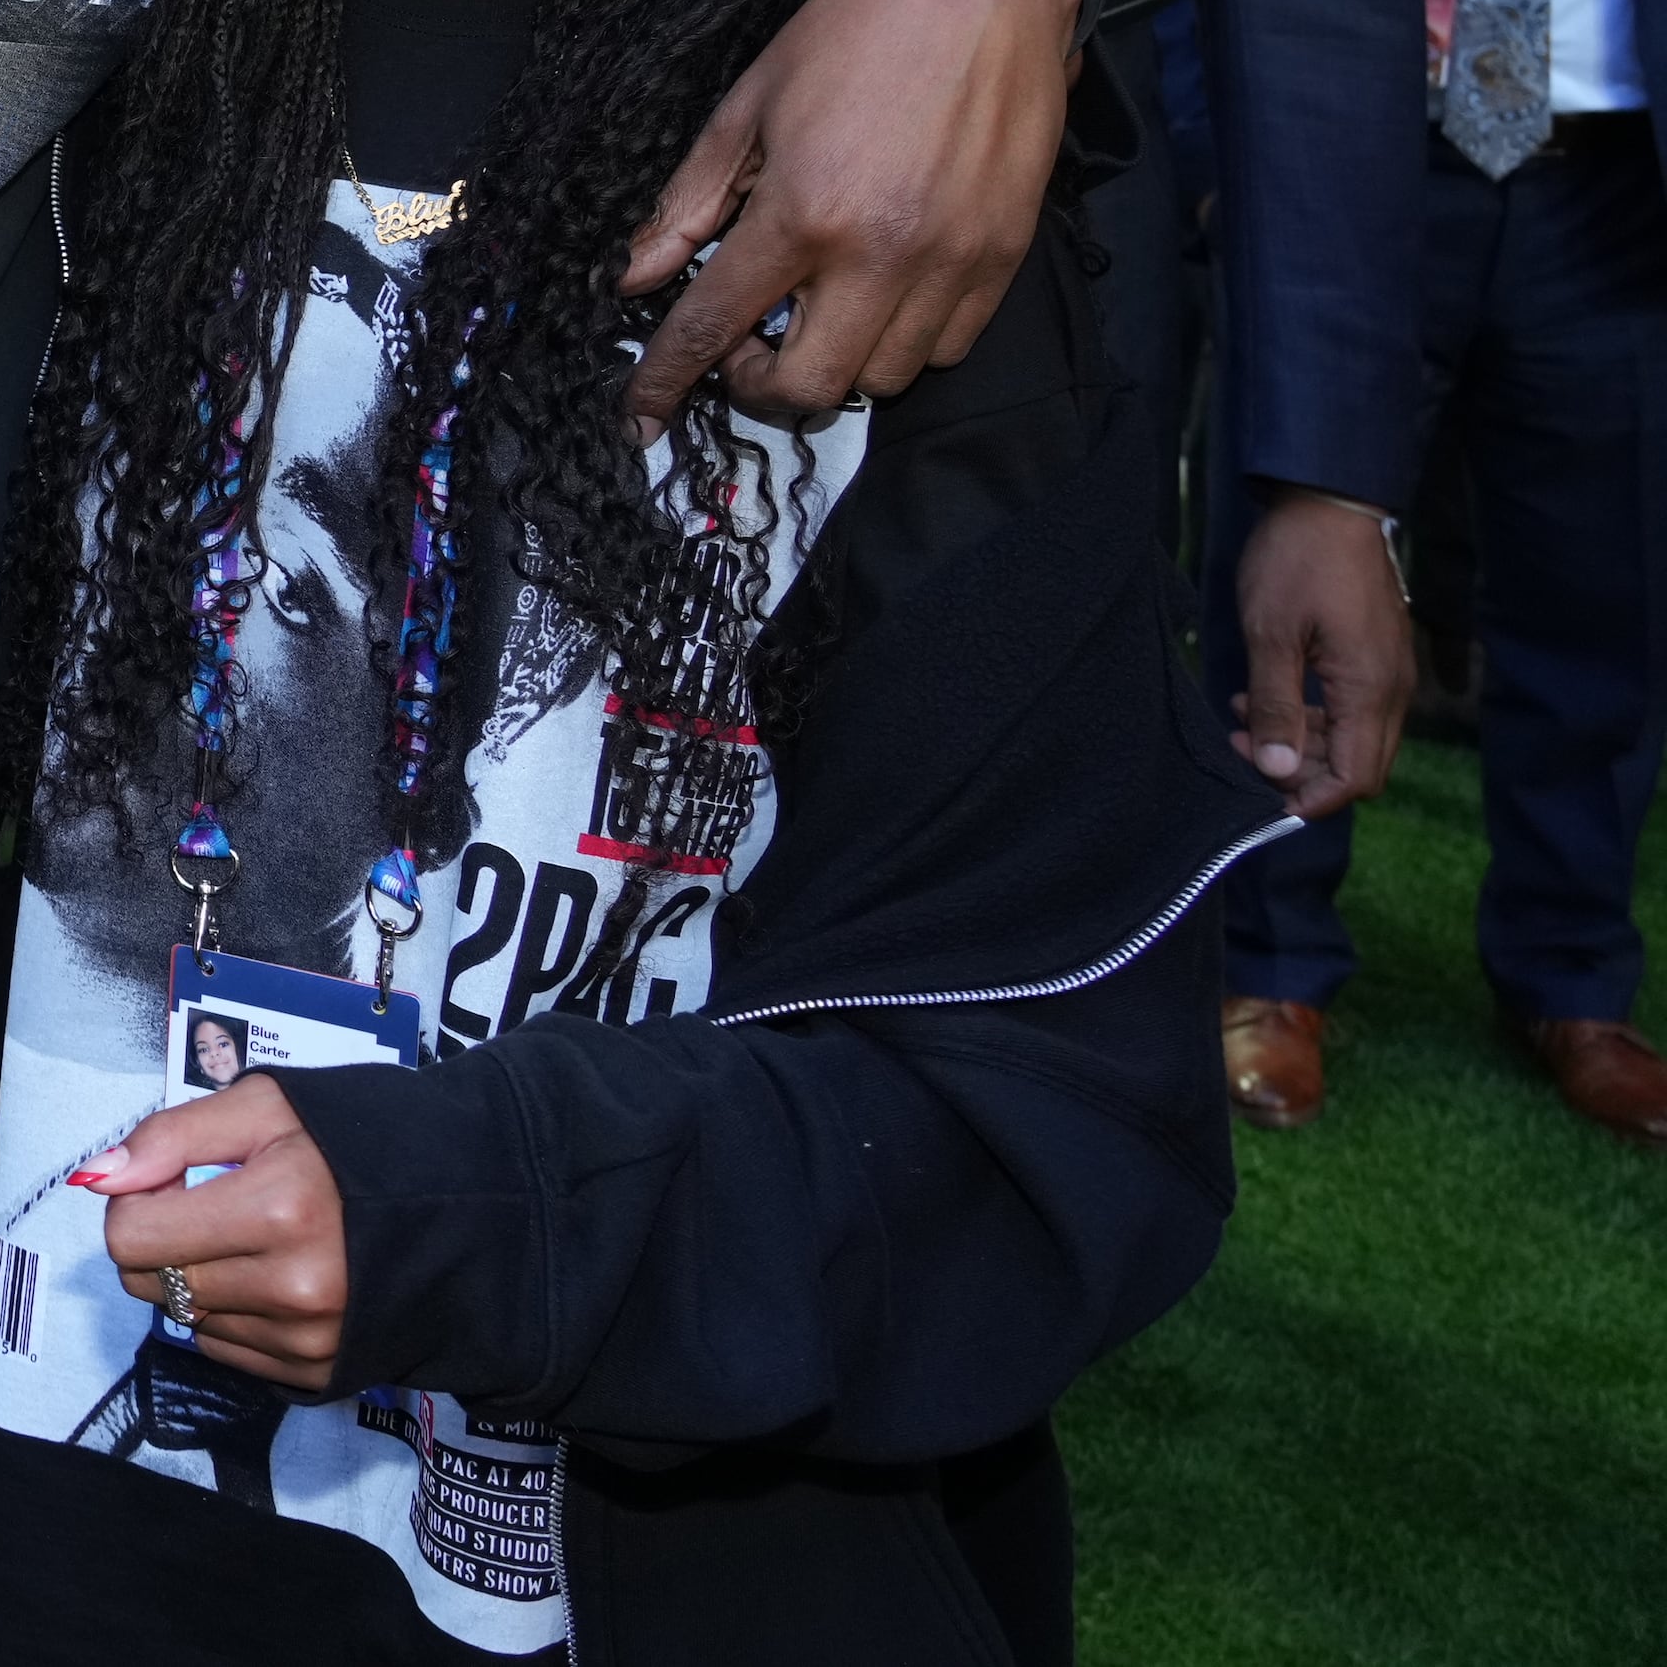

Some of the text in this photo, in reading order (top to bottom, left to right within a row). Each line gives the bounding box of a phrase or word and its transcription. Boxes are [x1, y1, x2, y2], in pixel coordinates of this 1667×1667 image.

[374, 191, 457, 235] Blu
[439, 842, 711, 1041] 2PAC
[250, 1040, 291, 1060] Carter
[251, 1025, 280, 1041] Blue
[486, 1465, 511, 1487] AT
[440, 1483, 544, 1528] PRODUCER
[427, 1504, 465, 1544] QUAD
[484, 1568, 543, 1596] SHOW
